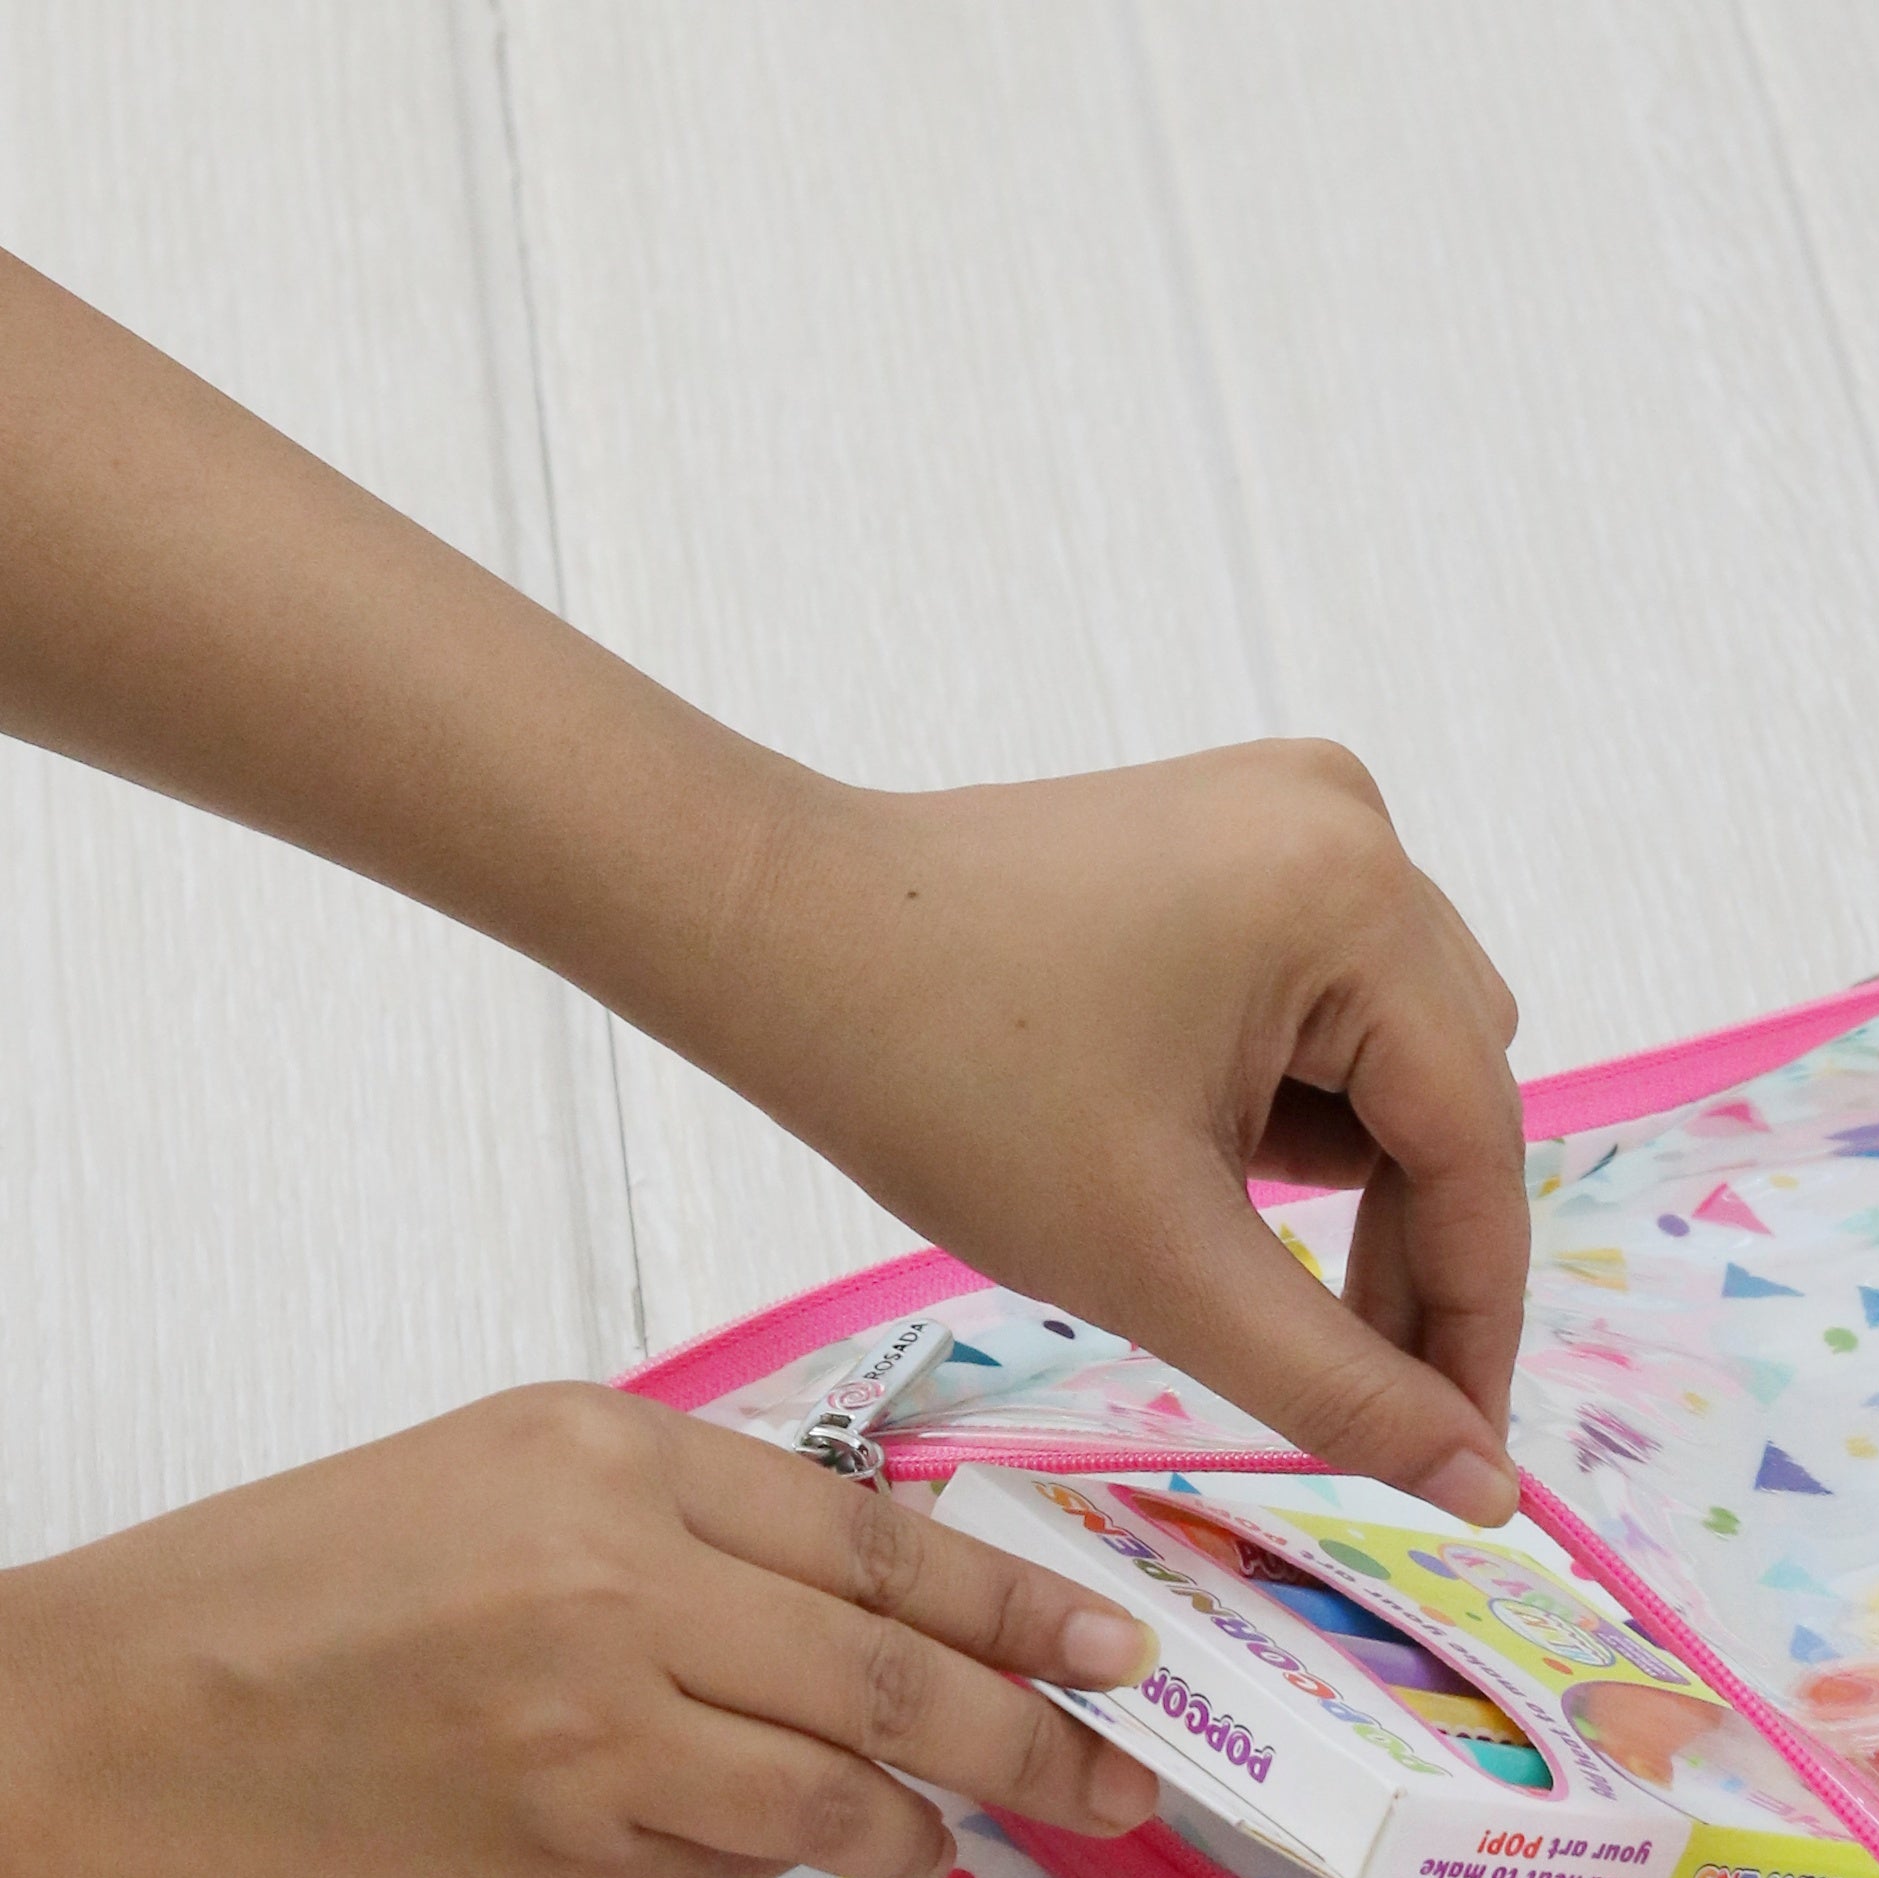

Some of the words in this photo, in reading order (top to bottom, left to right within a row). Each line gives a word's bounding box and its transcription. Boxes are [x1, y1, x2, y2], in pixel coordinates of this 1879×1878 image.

[863, 1322, 928, 1380] ROSADA
[1031, 1481, 1198, 1586] PENS
[1299, 1550, 1357, 1583] art
[1362, 1587, 1449, 1637] your
[1166, 1583, 1454, 1778] POPCORN
[1448, 1641, 1528, 1698] make
[1138, 1667, 1276, 1784] POPCOR
[1525, 1701, 1556, 1723] to
[1549, 1727, 1600, 1772] heat
[1476, 1829, 1544, 1860] POP!
[1547, 1837, 1588, 1860] art
[1591, 1840, 1653, 1865] your
